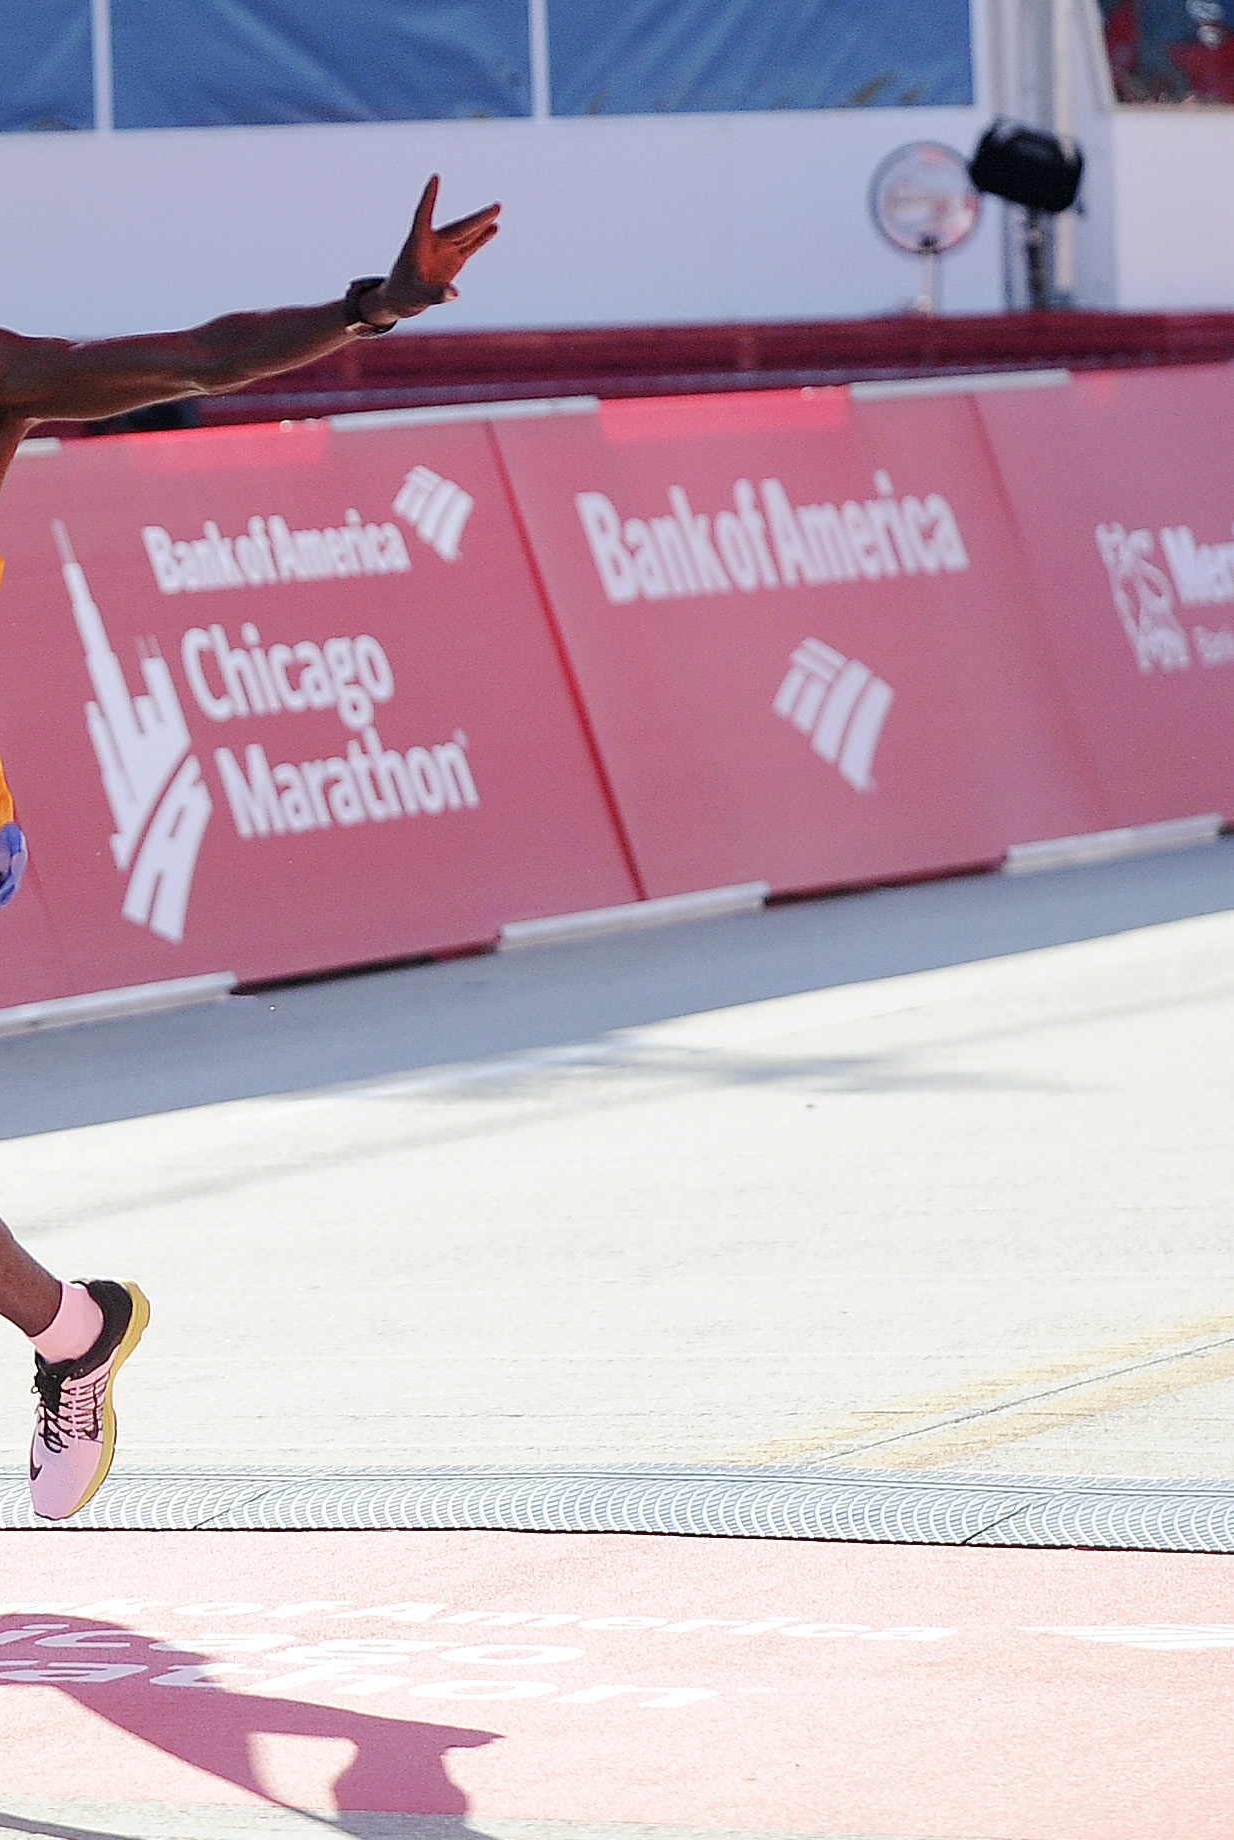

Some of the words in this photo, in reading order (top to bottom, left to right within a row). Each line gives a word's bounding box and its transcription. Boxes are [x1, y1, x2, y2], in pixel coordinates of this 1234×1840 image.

[141, 519, 246, 594] Bank
[235, 514, 279, 586] of
[268, 507, 413, 584] America
[575, 483, 733, 604] Bank
[714, 477, 780, 593] of
[761, 468, 970, 588] America
[180, 622, 395, 731] Chicago
[214, 724, 479, 839] Marathon
[326, 1600, 959, 1643] America
